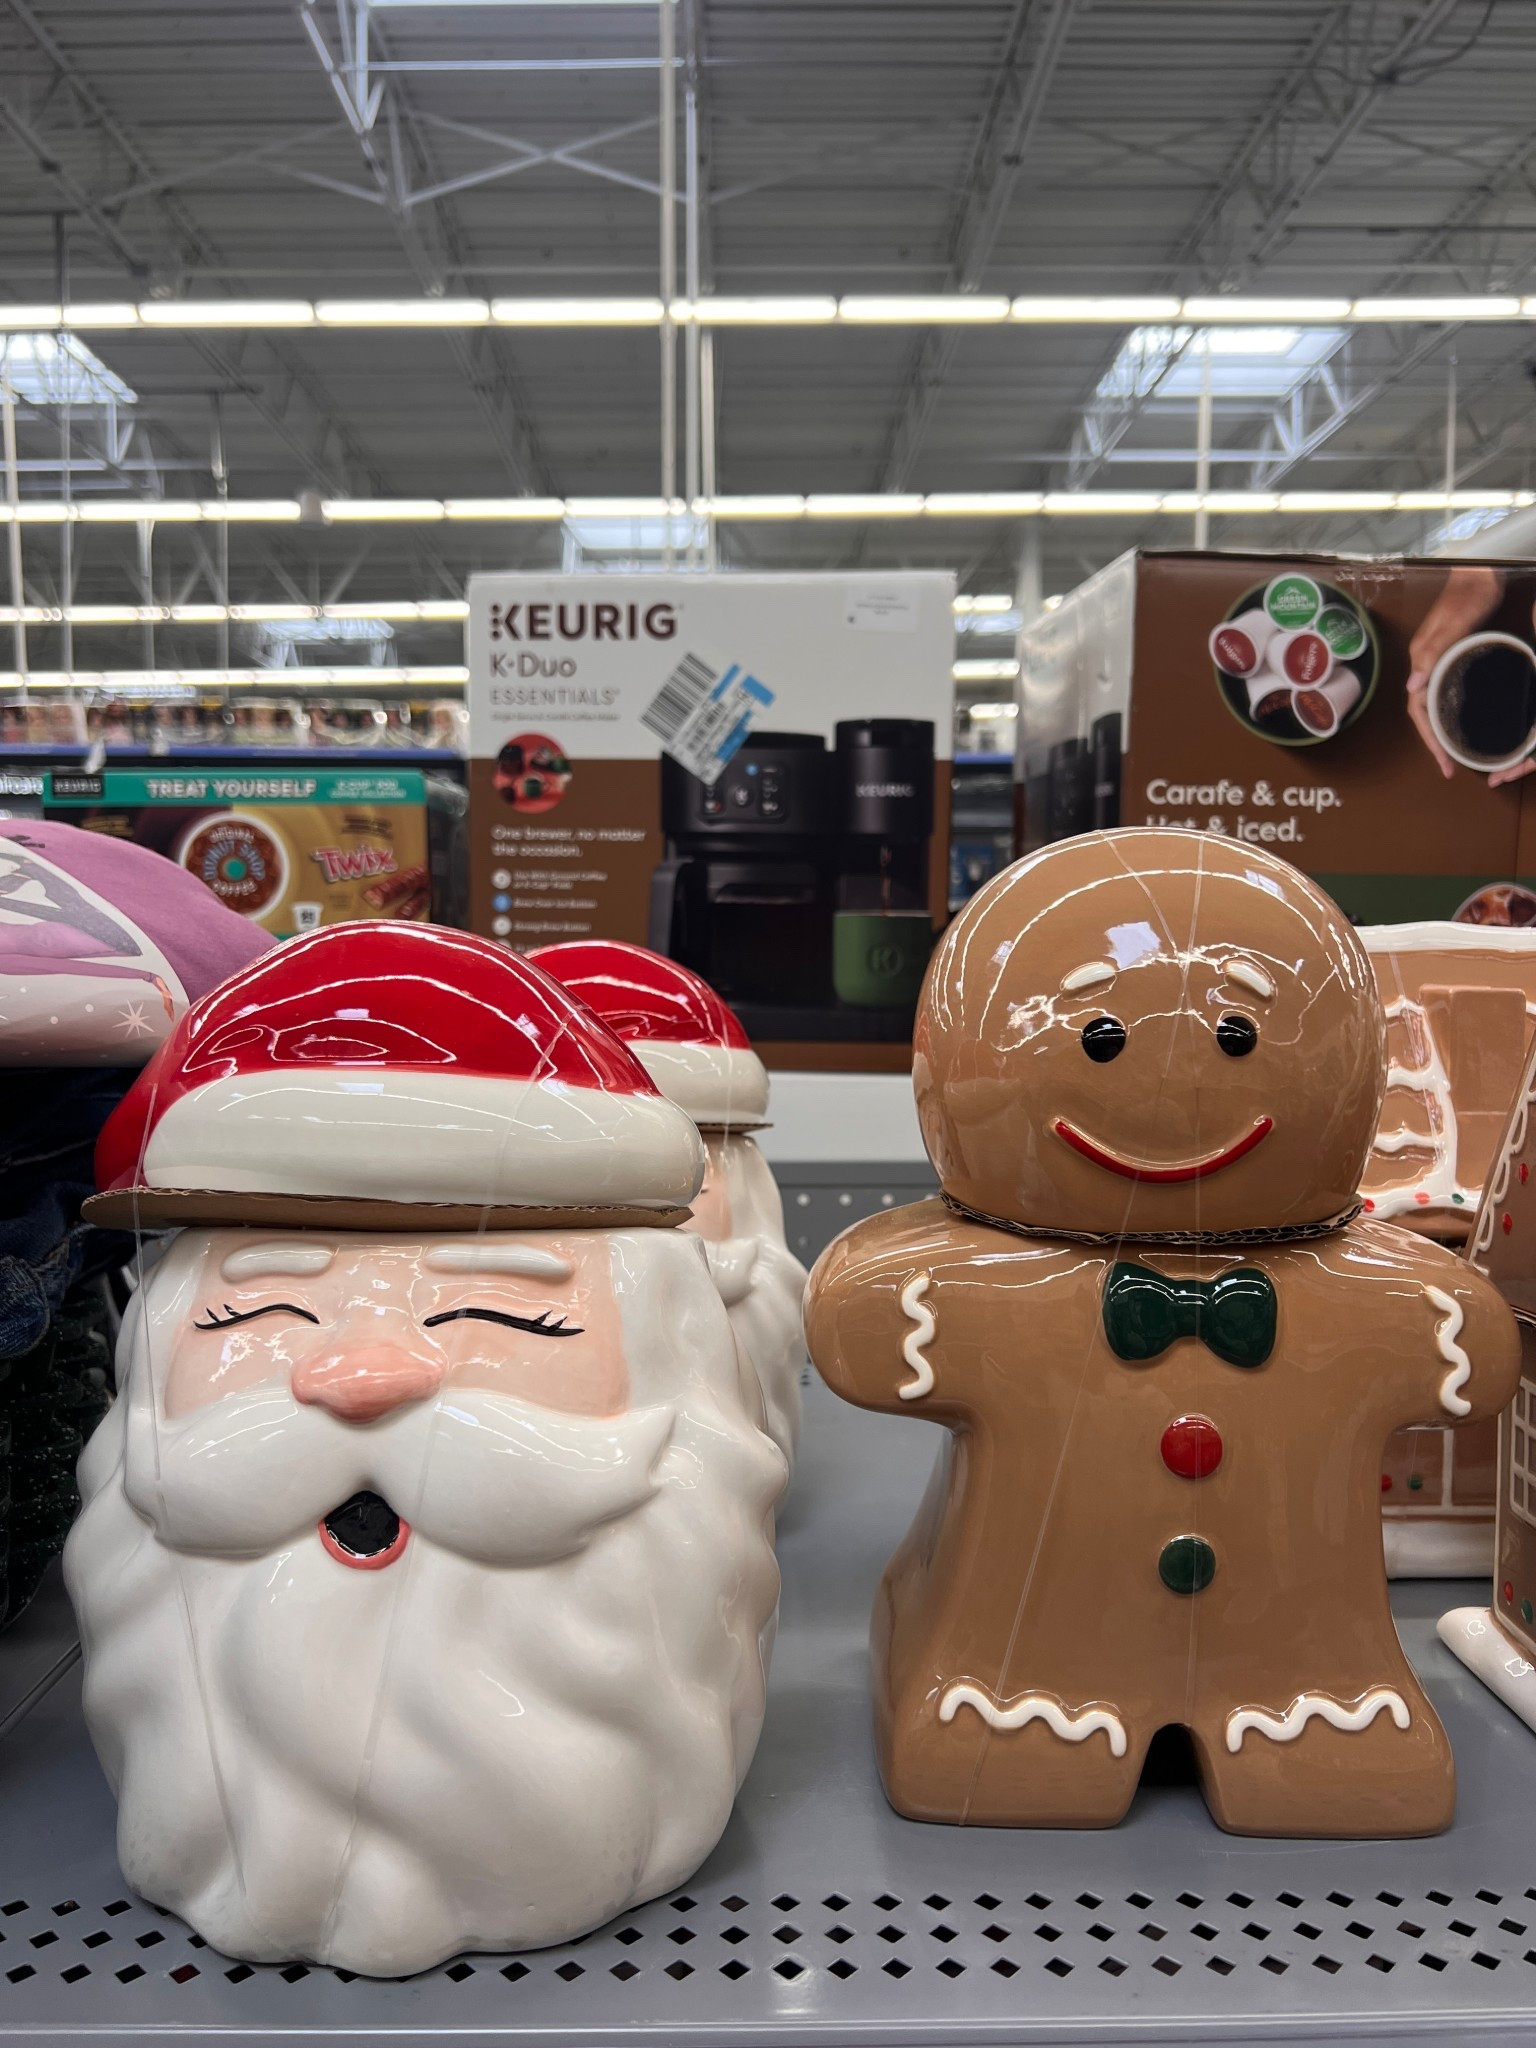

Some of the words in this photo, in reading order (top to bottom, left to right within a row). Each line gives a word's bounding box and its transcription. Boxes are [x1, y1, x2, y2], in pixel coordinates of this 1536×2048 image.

[490, 602, 678, 642] KEURIG
[490, 687, 616, 706] ESSENTIALS
[147, 779, 208, 799] TREAT
[213, 779, 318, 799] YOURSELF
[1146, 778, 1246, 806] Carafe
[1251, 779, 1277, 807] &
[1282, 786, 1343, 814] cup.
[491, 824, 522, 841] One
[577, 827, 597, 842] no
[598, 827, 648, 842] matter
[1236, 815, 1305, 842] iced.
[491, 842, 518, 857] the
